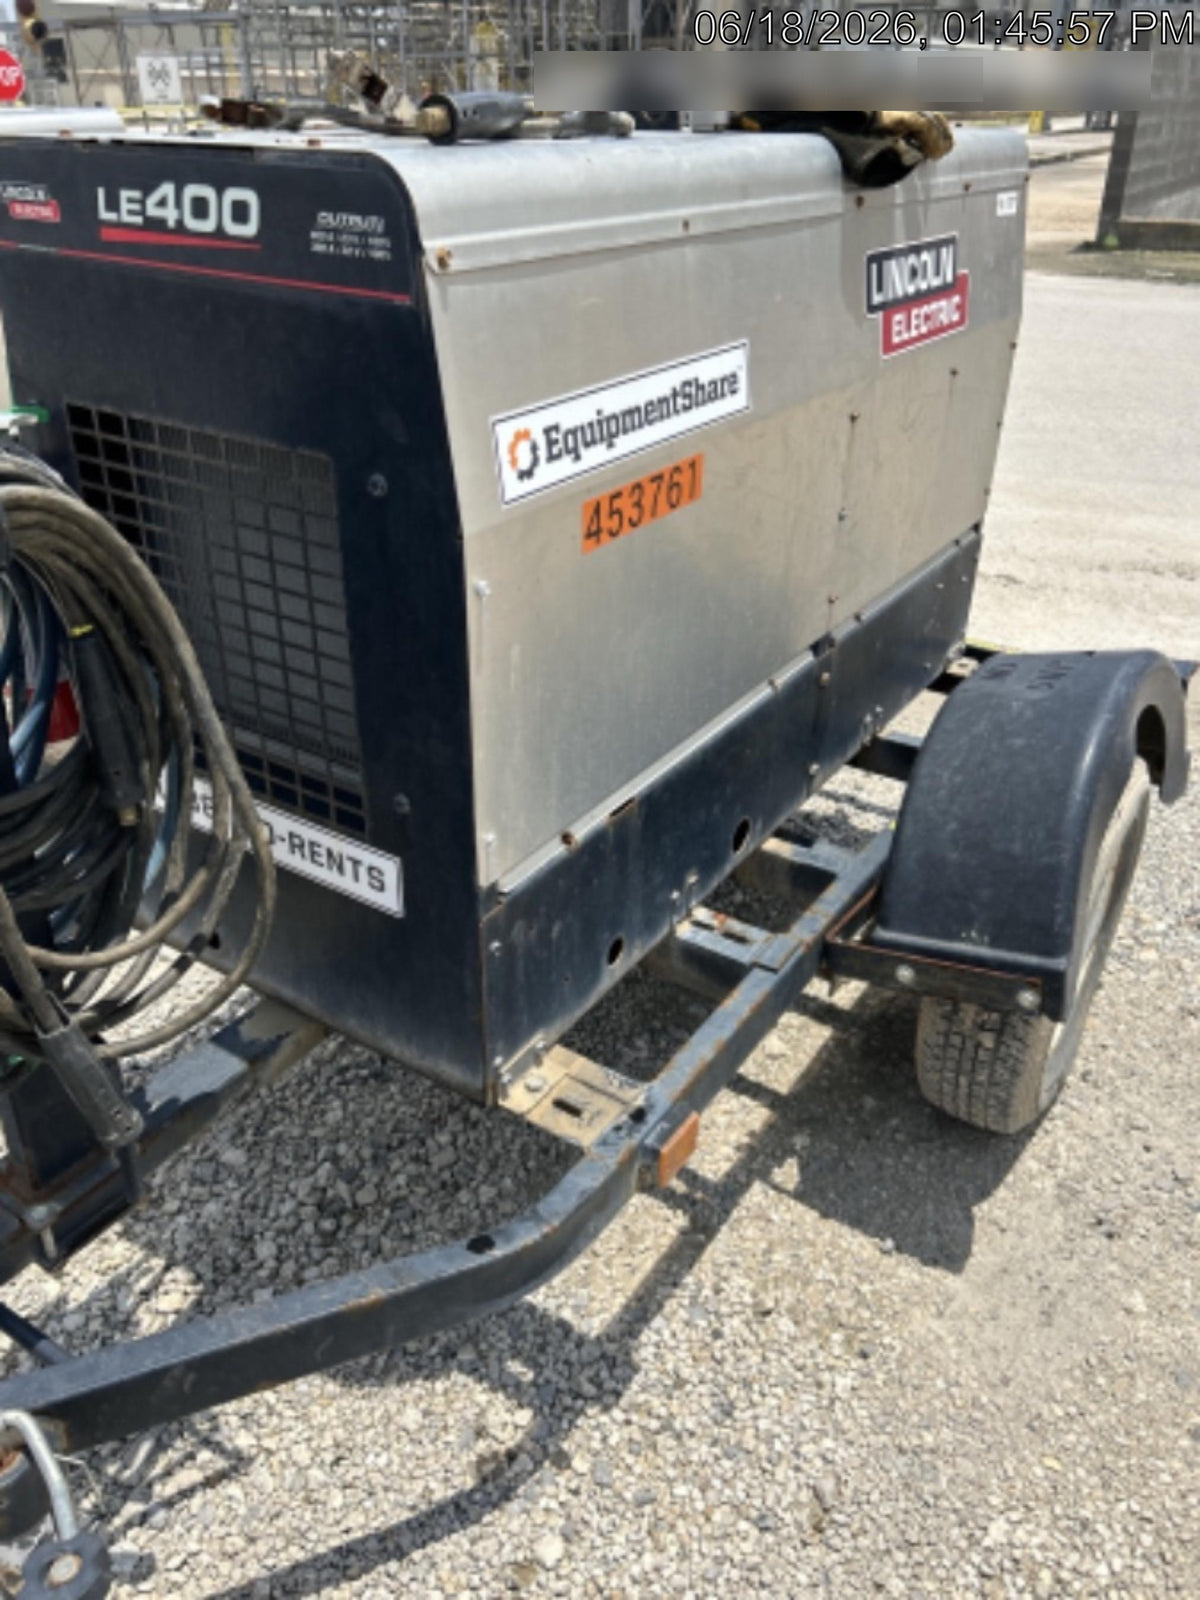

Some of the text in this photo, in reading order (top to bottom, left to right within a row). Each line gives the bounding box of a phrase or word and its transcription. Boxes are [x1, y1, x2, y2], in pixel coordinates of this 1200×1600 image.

[97, 181, 261, 239] LE400
[870, 243, 955, 305] LINCOLN
[891, 294, 962, 345] ELECTRIC
[542, 371, 739, 464] EquipmentShare
[584, 459, 697, 546] 453761
